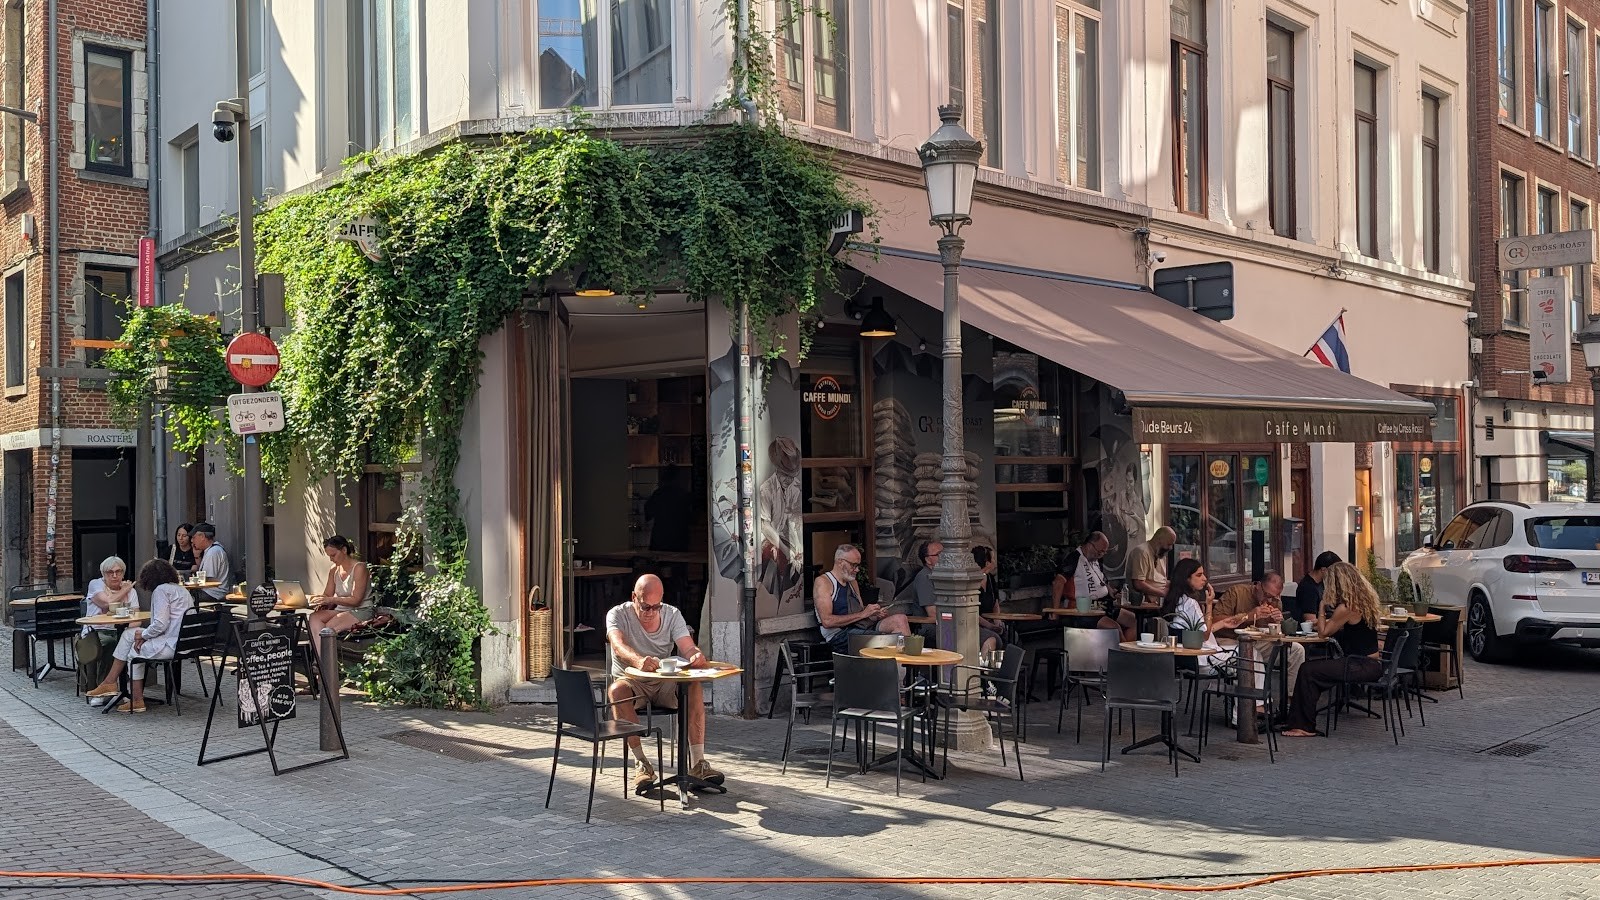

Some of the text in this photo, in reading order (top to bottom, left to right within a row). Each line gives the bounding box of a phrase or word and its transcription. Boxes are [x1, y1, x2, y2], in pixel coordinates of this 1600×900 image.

[1531, 241, 1586, 252] CROSS ROAST
[1509, 247, 1524, 258] CR
[1533, 353, 1562, 361] CHOCOLATE
[232, 396, 279, 406] UITGEZONDERD
[803, 391, 851, 404] CAFFE MUNDI
[1011, 399, 1047, 410] CAFFE MUNDI
[1160, 420, 1183, 434] Beurs
[1183, 421, 1193, 434] 24
[1266, 420, 1336, 436] Caffe Mundi
[267, 649, 292, 660] people
[272, 698, 293, 706] TAKE-OUT
